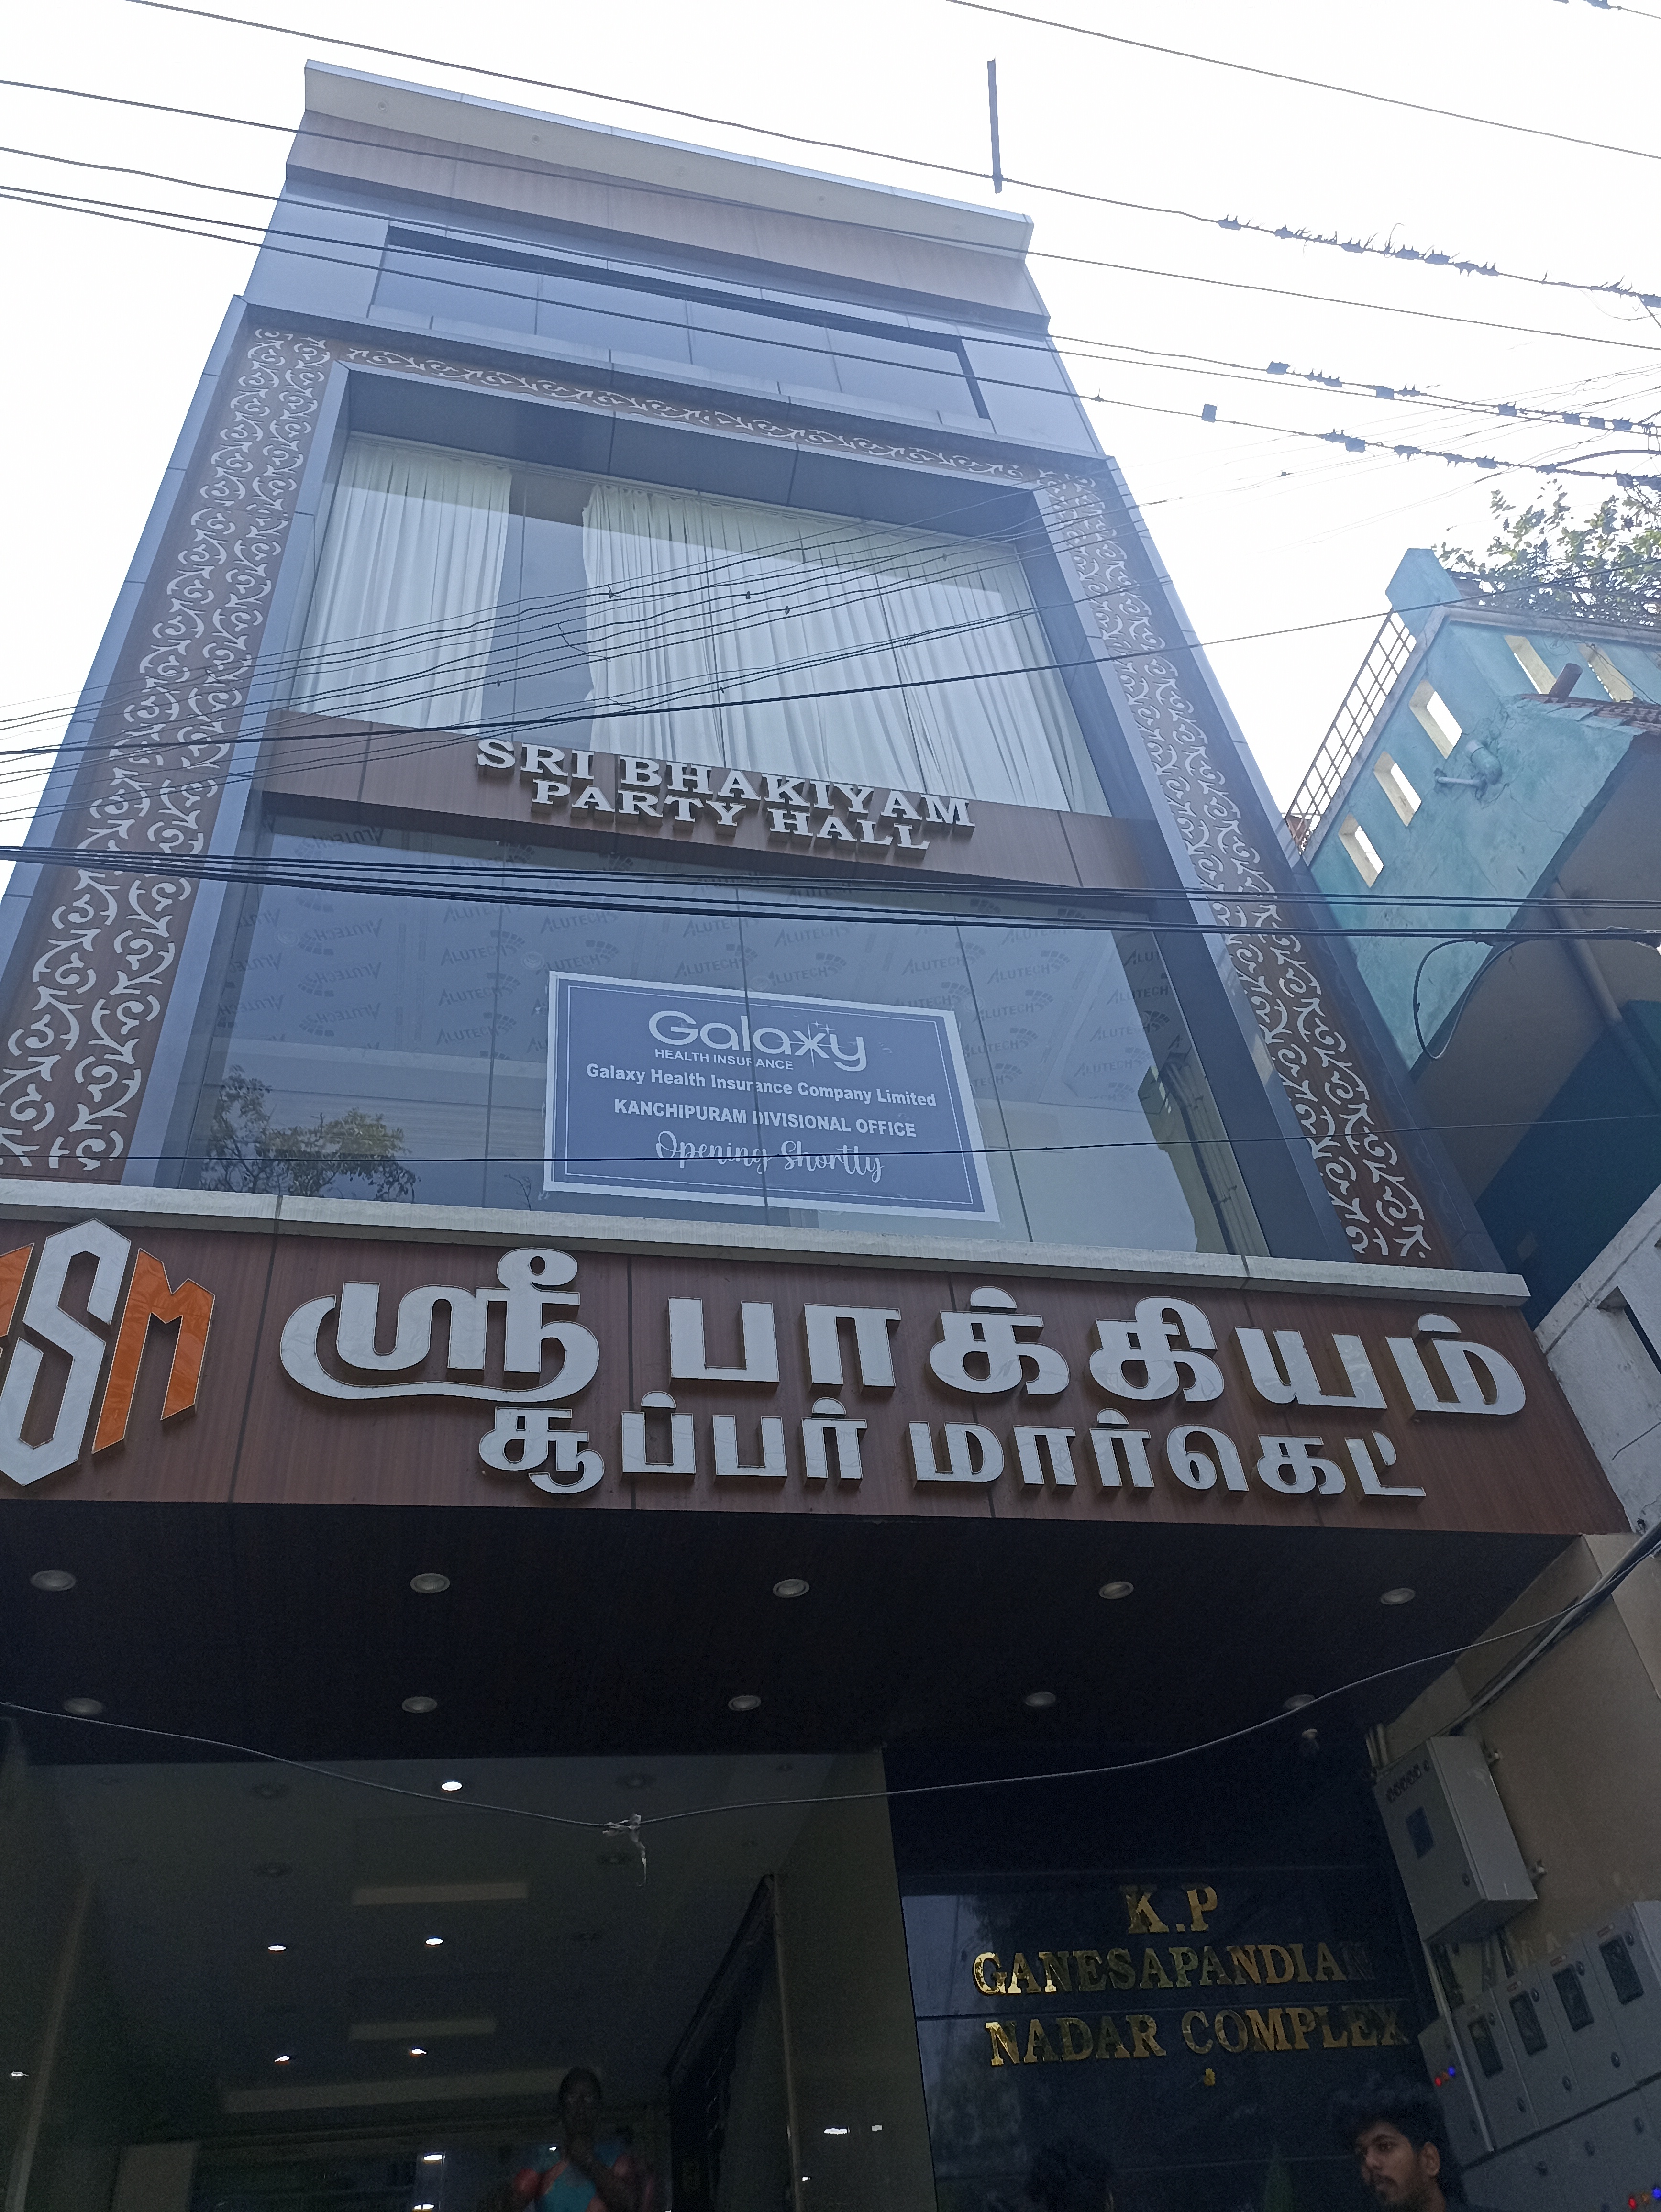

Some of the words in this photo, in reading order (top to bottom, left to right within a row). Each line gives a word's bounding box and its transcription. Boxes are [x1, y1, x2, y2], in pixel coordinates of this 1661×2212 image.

[477, 738, 595, 780] SRI
[620, 755, 976, 827] BHAKIYAM
[532, 778, 747, 827] PARTY
[767, 807, 931, 851] HALL
[313, 918, 382, 941] ALUTECH
[540, 911, 608, 934] ALUTECH
[774, 926, 841, 947] ALUTECH
[316, 962, 382, 984] ALUTECH
[674, 957, 740, 979] ALUTECH
[987, 965, 1051, 985] ALUTECH
[1107, 985, 1169, 1005] ALUTECH
[649, 1010, 867, 1072] Galaxy
[655, 1049, 710, 1063] HEALTH
[713, 1054, 794, 1071] INSURANCE
[587, 1063, 646, 1084] Galaxy
[651, 1068, 706, 1088] Health
[711, 1073, 792, 1095] Insurance
[797, 1082, 872, 1105] Company
[876, 1088, 937, 1107] Limited
[1074, 1059, 1132, 1077] ALUTECH
[614, 1099, 747, 1125] KANCHIPURAM
[753, 1111, 852, 1133] DIVISIONAL
[856, 1119, 917, 1138] OFFICE
[656, 1130, 771, 1174] Opening
[781, 1140, 884, 1183] Shortly
[0, 1218, 215, 1486] SM
[280, 1247, 600, 1402] ஸ்ரீ
[668, 1286, 1527, 1417] பாக்கியம்
[479, 1390, 868, 1494] சூப்பர்
[909, 1408, 1426, 1498] மார்கெட்
[1119, 1883, 1219, 1934] K.P
[973, 1942, 1377, 1995] GANESAPANDIAN
[985, 2014, 1167, 2066] NADAR
[1182, 2003, 1411, 2055] COMPLEX
